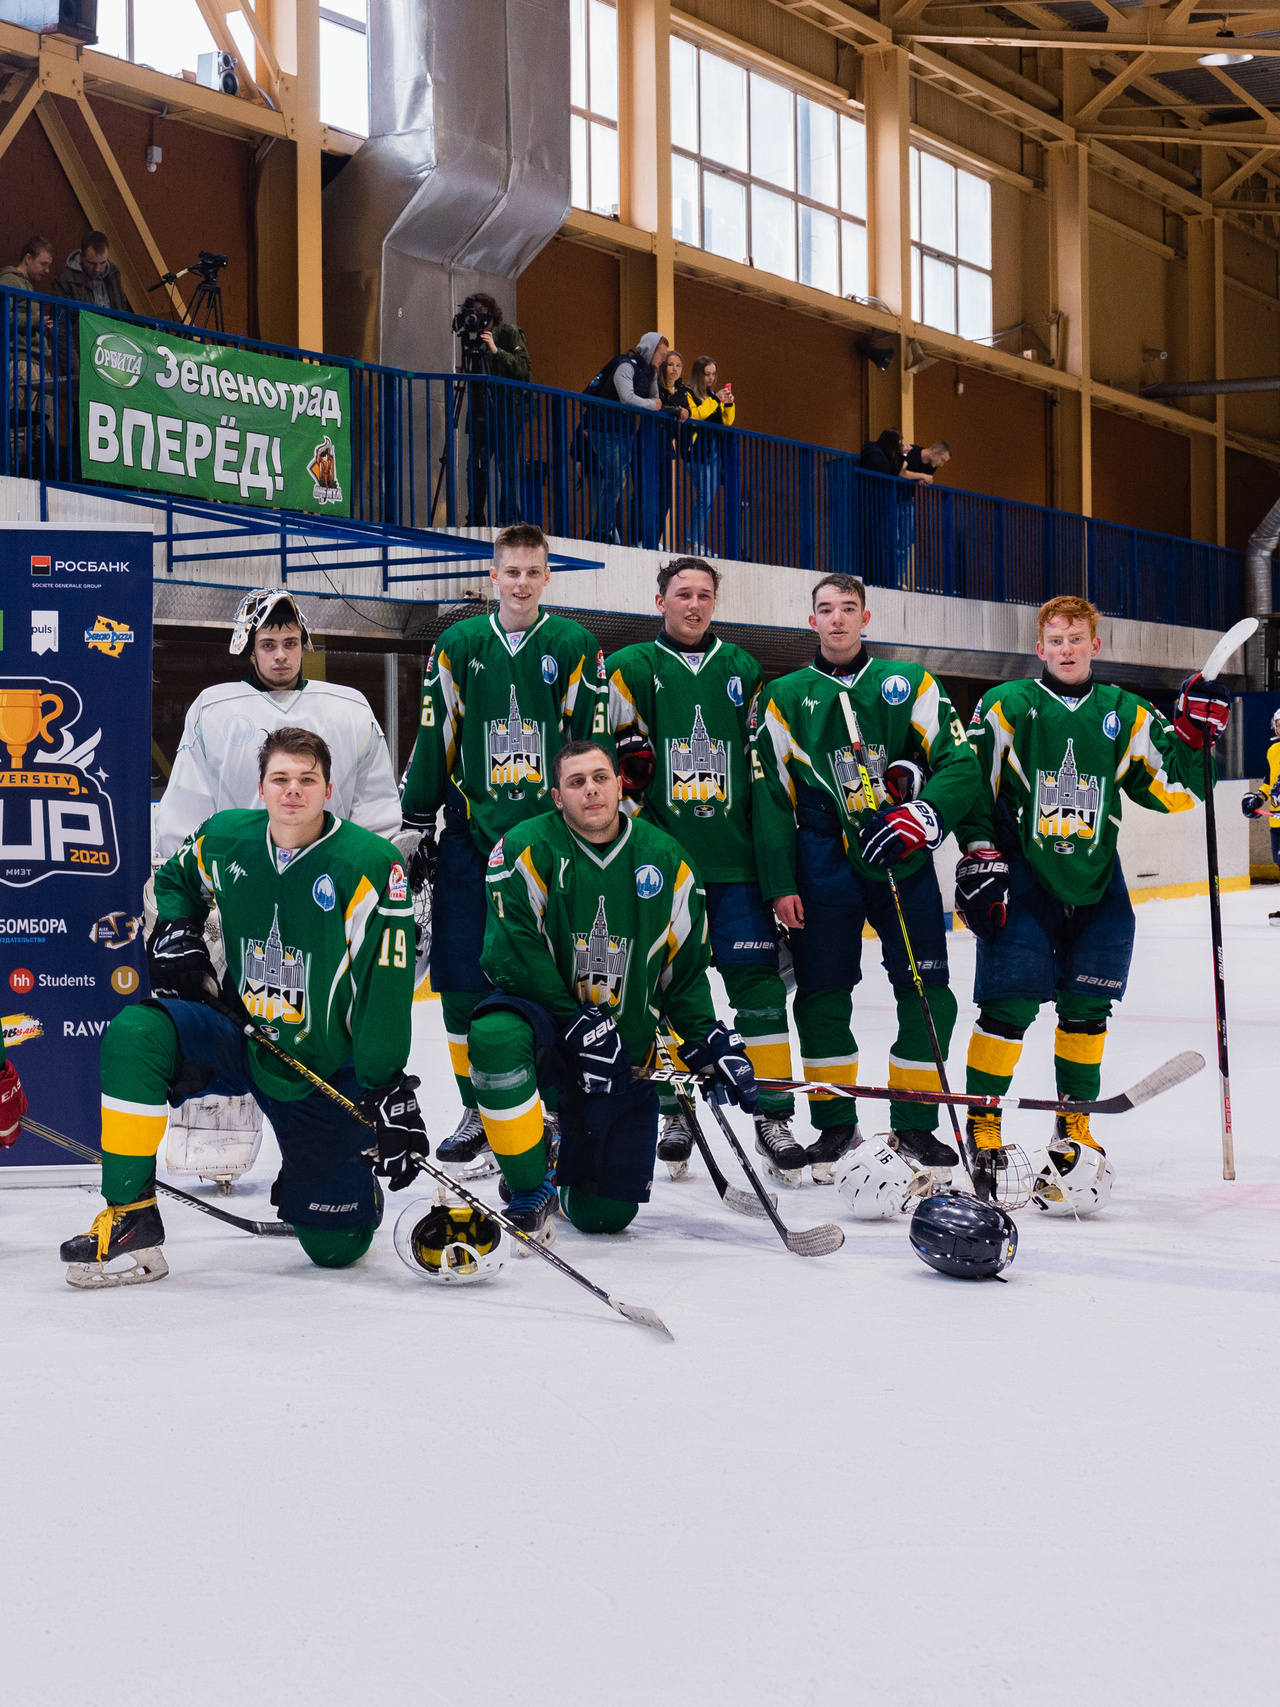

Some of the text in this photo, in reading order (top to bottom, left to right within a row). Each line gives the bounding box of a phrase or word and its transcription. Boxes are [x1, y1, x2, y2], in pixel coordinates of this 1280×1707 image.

[94, 346, 142, 376] ОРБИТА
[155, 345, 342, 428] Зеленоград
[88, 400, 284, 500] ВПЕРЁД!
[55, 561, 130, 573] РОСБАНК
[32, 625, 52, 635] puls
[861, 772, 874, 804] CCM
[69, 849, 110, 865] 2020
[6, 868, 31, 876] МИЭТ
[378, 928, 407, 968] 19
[733, 941, 775, 950] BAUER
[13, 974, 30, 986] hh
[38, 974, 96, 987] Students
[117, 972, 133, 989] U
[1076, 974, 1123, 989] BAUER
[582, 1020, 617, 1048] BAU
[650, 1069, 704, 1086] BAU
[1, 1078, 22, 1103] EAS
[308, 1202, 359, 1213] BAUER
